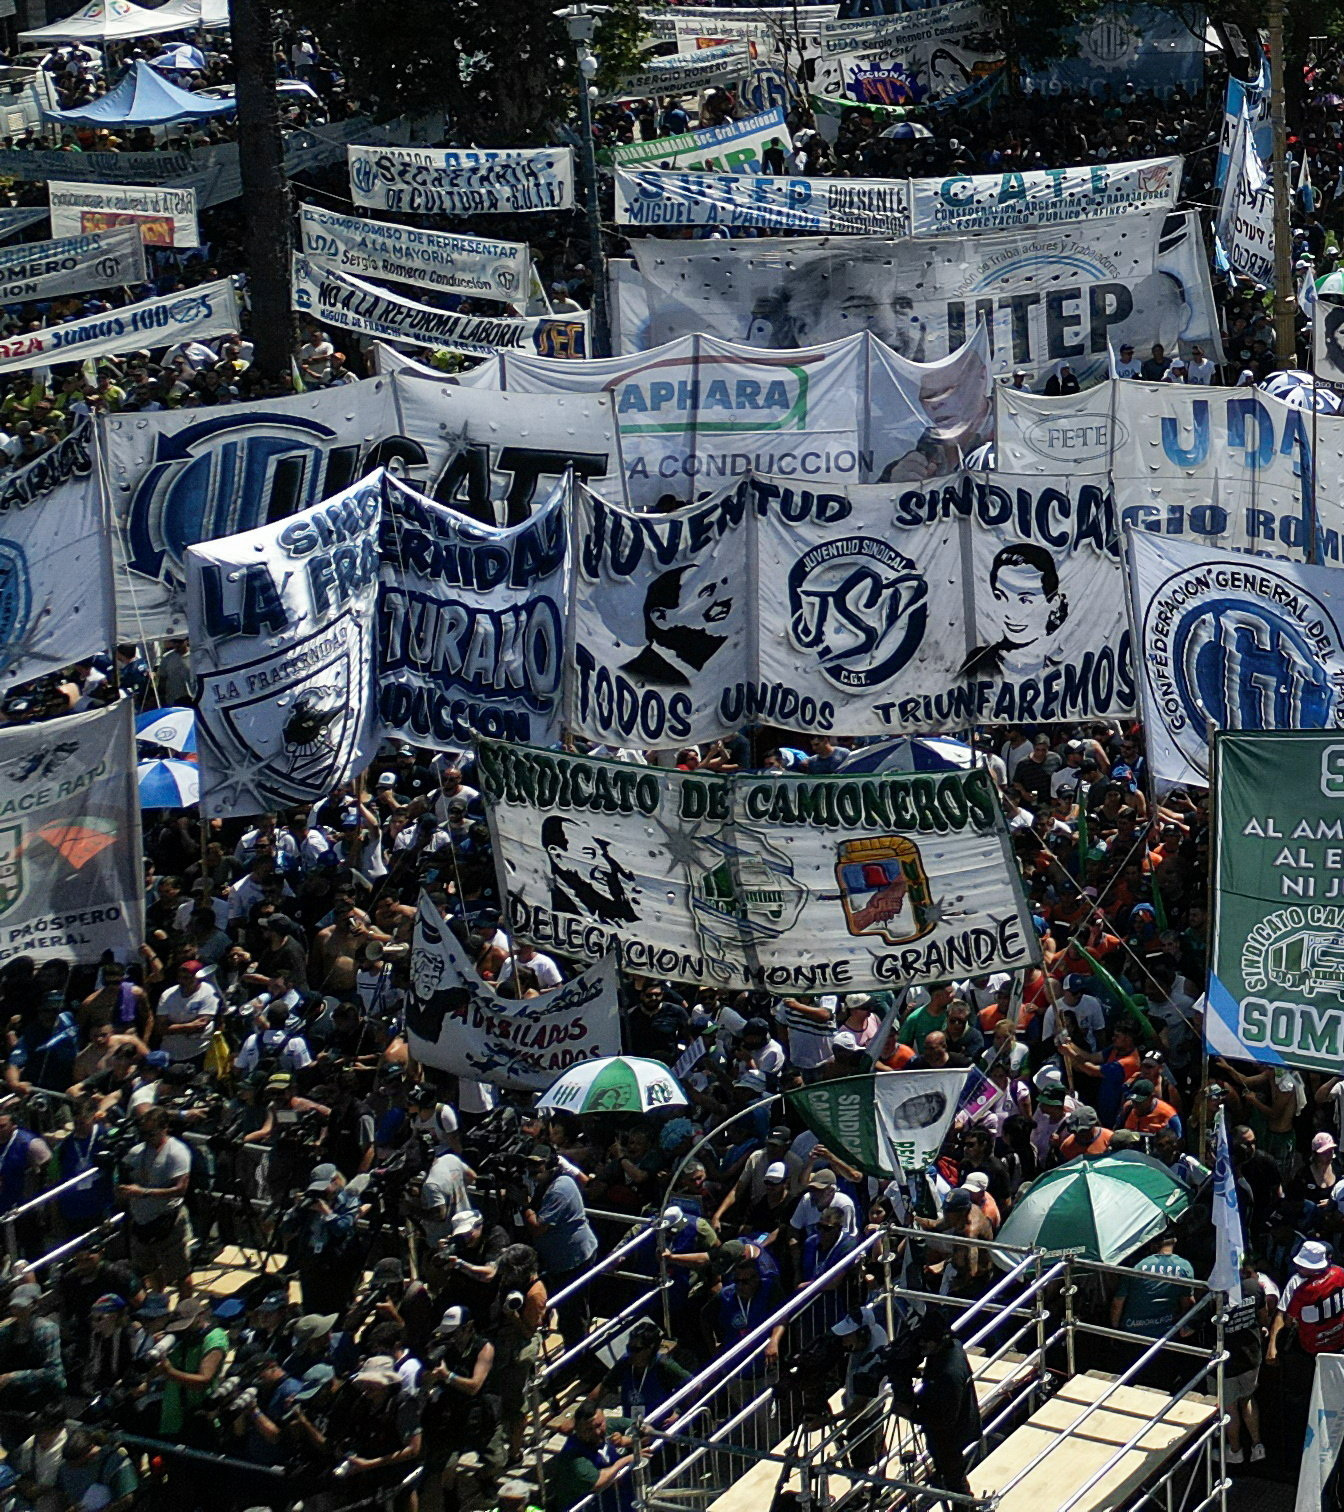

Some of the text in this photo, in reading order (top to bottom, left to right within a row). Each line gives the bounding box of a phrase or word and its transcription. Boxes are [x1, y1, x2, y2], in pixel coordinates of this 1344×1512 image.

[410, 187, 499, 212] CULTURA
[407, 231, 425, 245] DE
[427, 236, 518, 260] REPRESENTAR
[355, 296, 377, 318] LA
[381, 303, 460, 335] REFORMA
[460, 317, 526, 349] LABORAL
[947, 282, 1133, 365] UTEP
[581, 477, 1130, 580] JUVENTUD SINDICAL
[802, 536, 912, 573] JUVENTUD SINDICAL
[574, 644, 693, 740] TODOS
[876, 627, 1136, 726] TRIUNFAREMOS
[477, 744, 999, 835] SINDICATO DE CAMIONEROS
[1243, 816, 1283, 839] AL
[1273, 846, 1314, 870] AL
[1281, 875, 1315, 898] NI
[9, 906, 121, 945] PRÓSPERO
[508, 891, 1027, 988] DELEGACION MONTE GRANDE
[1241, 906, 1304, 993] SINDICATO
